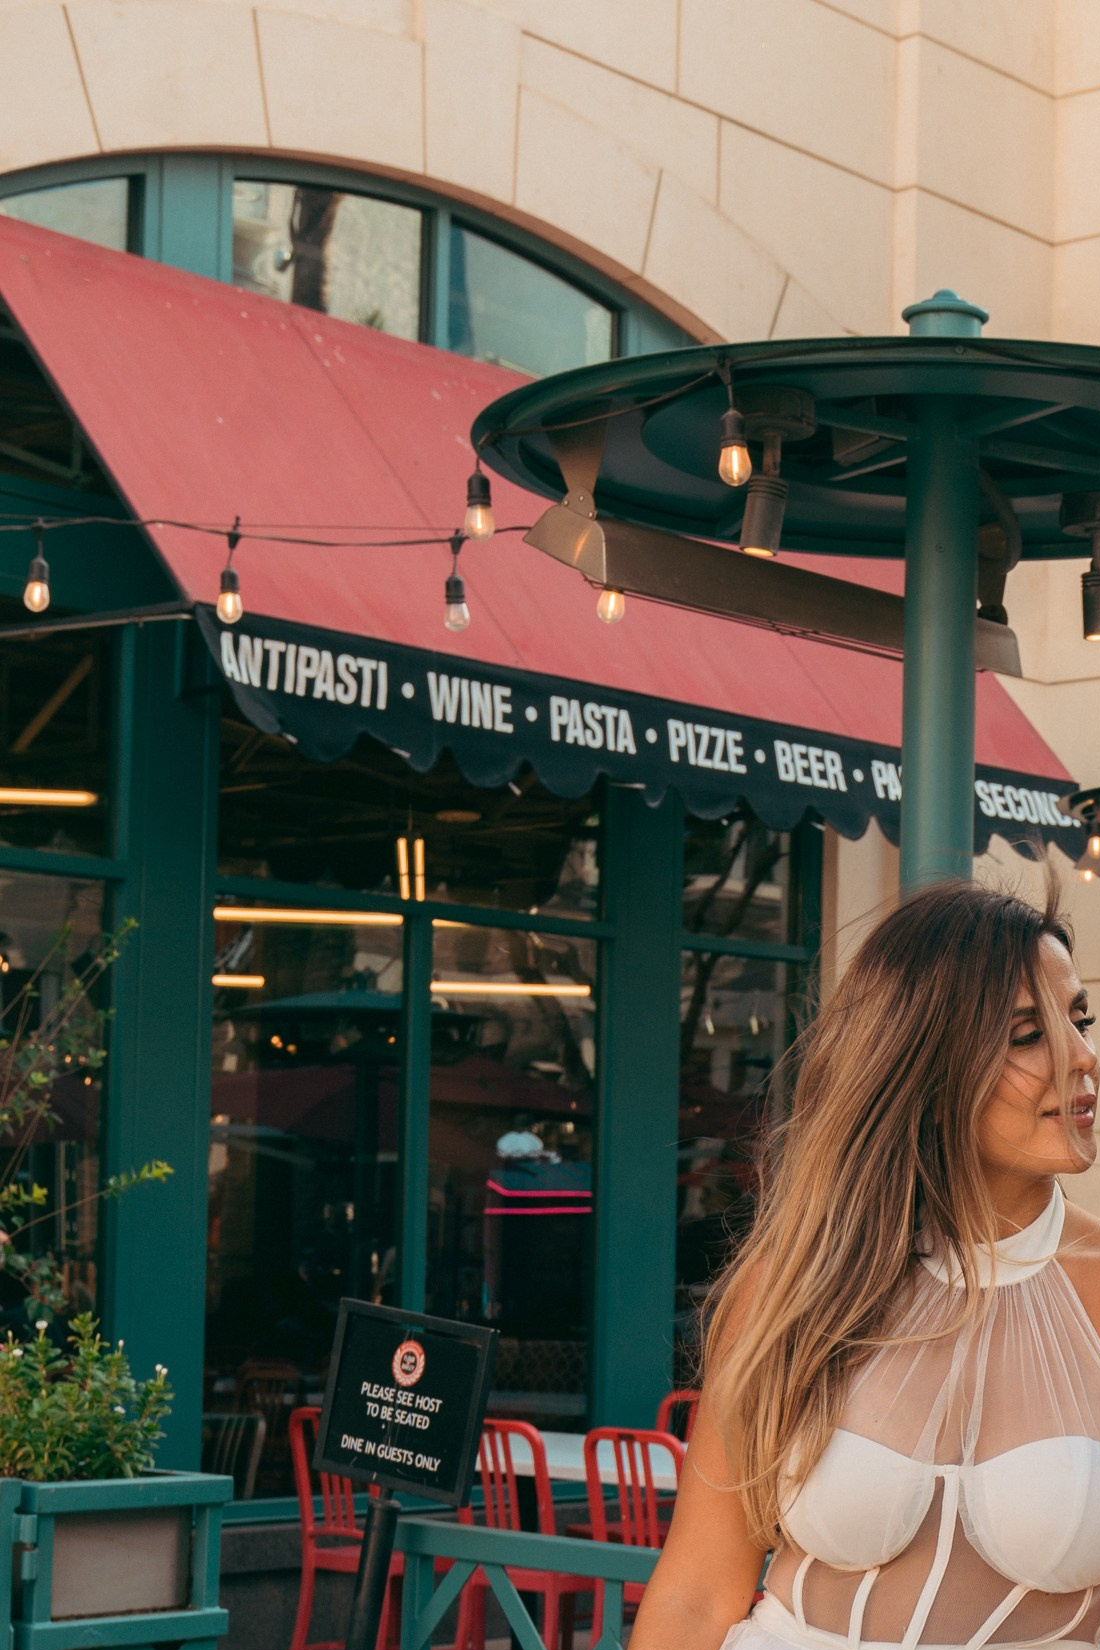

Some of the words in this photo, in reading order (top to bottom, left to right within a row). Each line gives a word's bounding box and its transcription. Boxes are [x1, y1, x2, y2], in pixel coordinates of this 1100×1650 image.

[220, 632, 388, 711] ANTIPASTI
[427, 671, 514, 734] WINE
[550, 695, 637, 755] PASTA
[667, 718, 747, 774] PIZZE
[774, 739, 847, 792] BEER
[361, 1381, 396, 1402] PLEASE
[396, 1389, 415, 1407] SEE
[415, 1394, 443, 1413] HOST
[366, 1402, 379, 1417] TO
[380, 1405, 394, 1421] BE
[394, 1409, 430, 1430] SEATED
[341, 1434, 364, 1452] DINE
[364, 1440, 376, 1455] IN
[377, 1444, 414, 1466] GUESTS
[415, 1453, 441, 1472] ONLY
